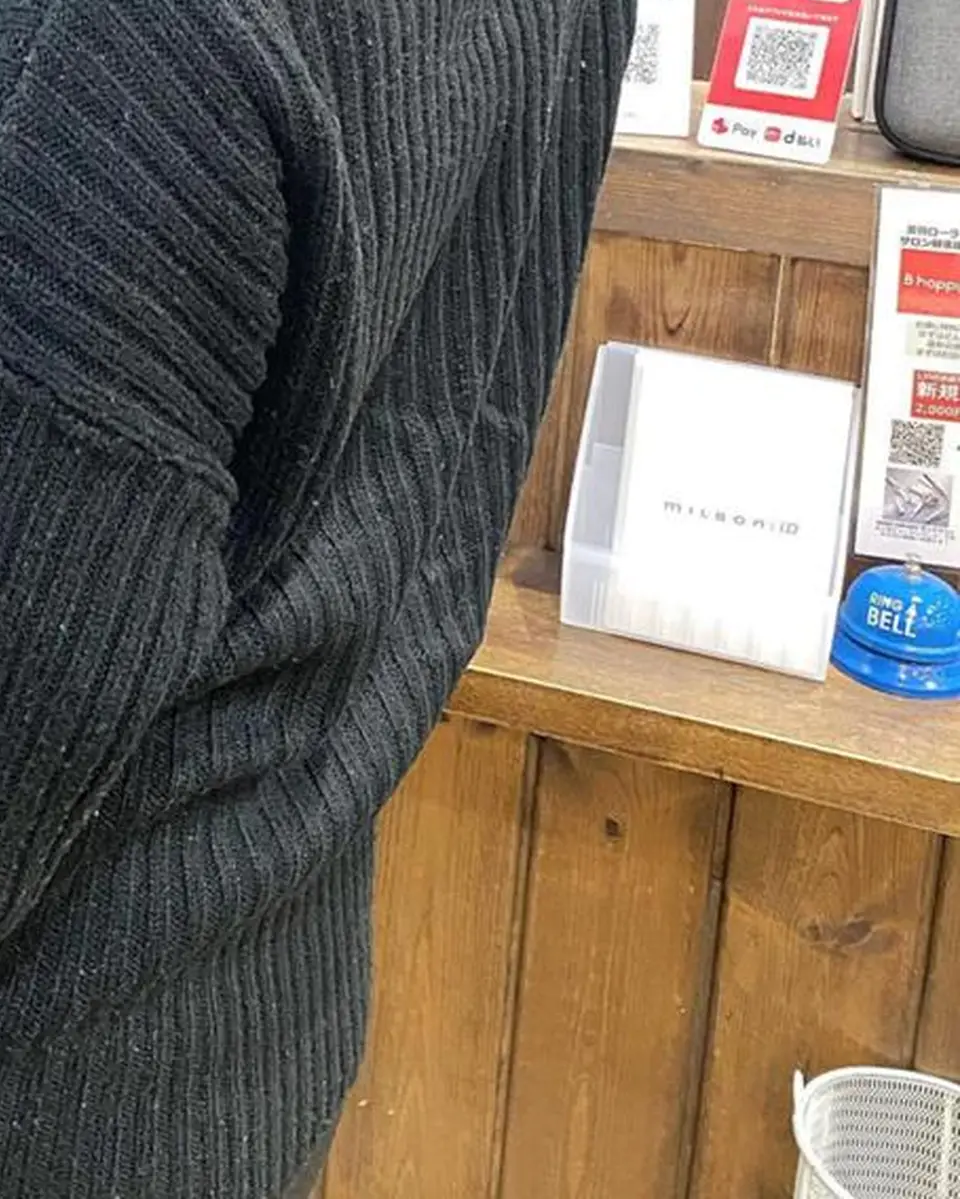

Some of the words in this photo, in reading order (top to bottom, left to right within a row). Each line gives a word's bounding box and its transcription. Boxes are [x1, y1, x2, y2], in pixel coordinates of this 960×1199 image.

[731, 121, 758, 140] Pay
[869, 591, 903, 613] RING
[866, 605, 917, 638] BELL
